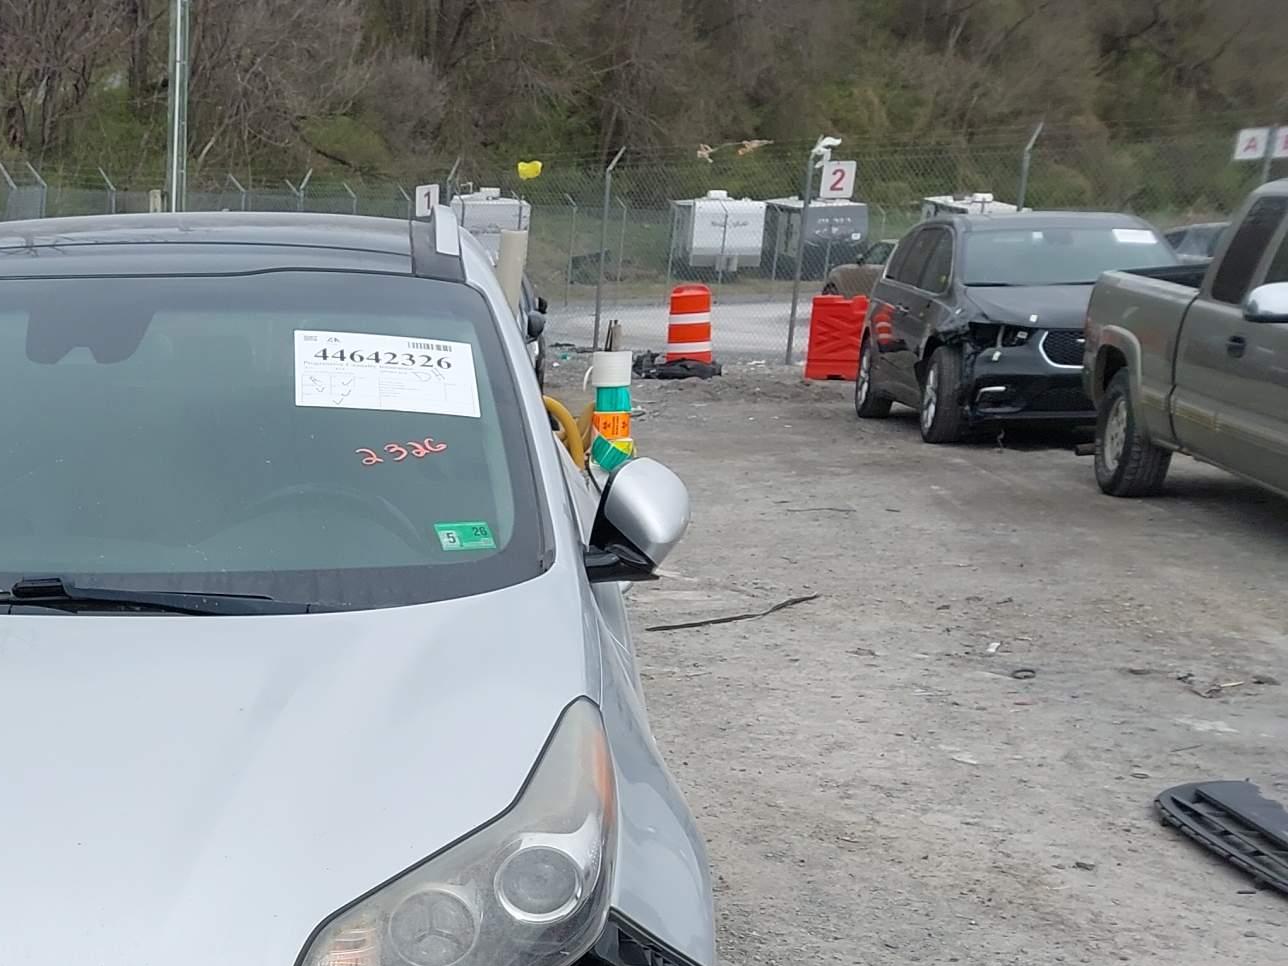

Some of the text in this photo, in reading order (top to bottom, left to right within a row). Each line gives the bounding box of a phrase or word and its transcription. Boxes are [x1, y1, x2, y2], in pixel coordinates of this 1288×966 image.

[829, 168, 846, 191] 2
[423, 191, 431, 210] 1
[313, 347, 452, 370] 44642326
[355, 438, 448, 465] 2326
[446, 532, 457, 544] 5
[472, 526, 488, 537] 26
